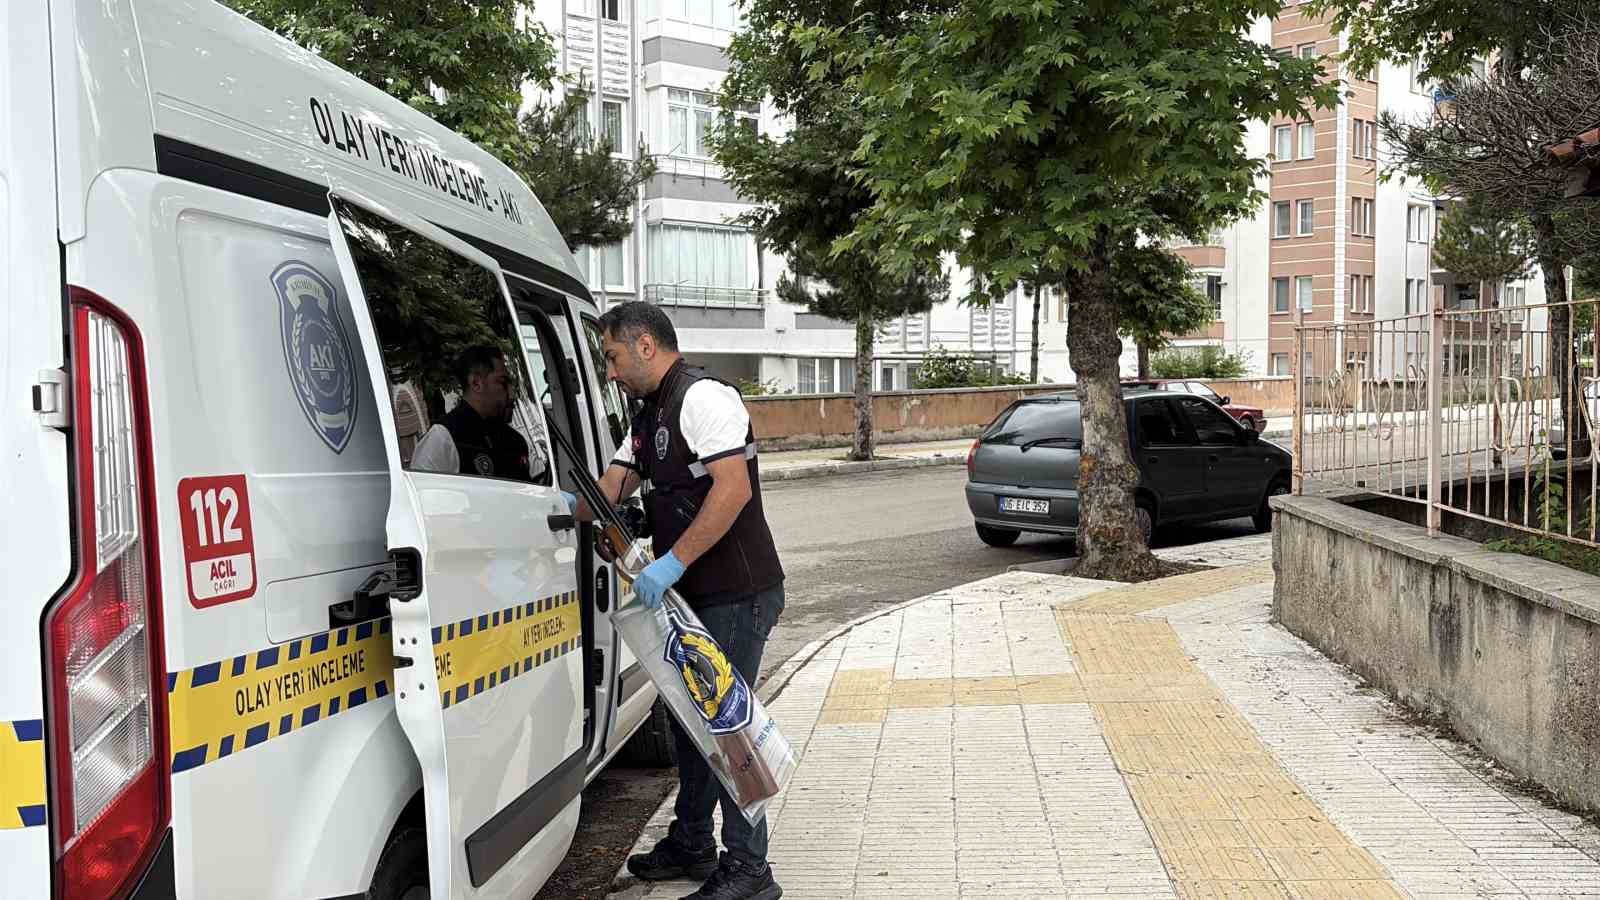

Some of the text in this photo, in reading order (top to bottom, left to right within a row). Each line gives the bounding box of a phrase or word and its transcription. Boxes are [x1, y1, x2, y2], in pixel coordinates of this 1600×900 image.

[310, 96, 369, 160] OLAY
[368, 123, 418, 181] YERİ
[415, 145, 494, 212] İNCELEME
[498, 185, 523, 226] AKİ
[190, 486, 244, 547] 112
[235, 650, 366, 716] OLAY YERİ İNCELEME
